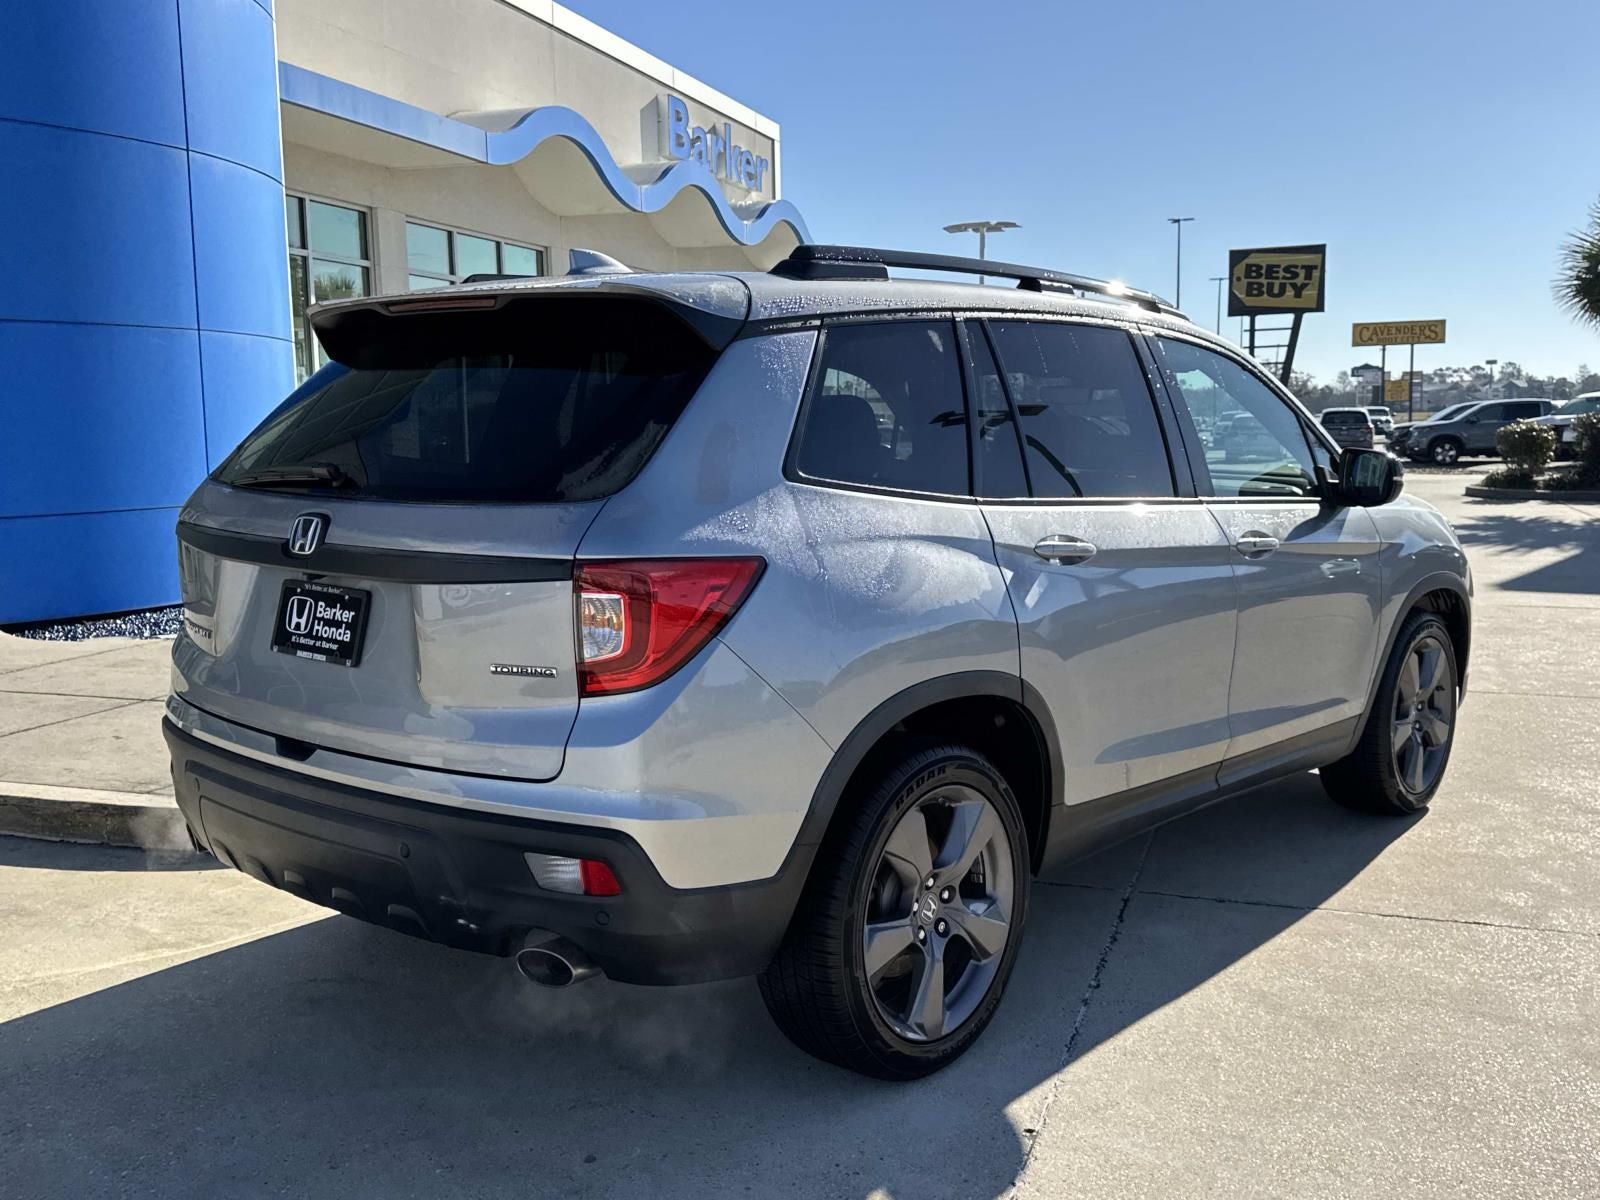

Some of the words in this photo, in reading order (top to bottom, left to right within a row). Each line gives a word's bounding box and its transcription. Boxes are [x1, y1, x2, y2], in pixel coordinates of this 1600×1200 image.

[667, 94, 769, 193] Barker
[1244, 263, 1319, 281] BEST
[1245, 281, 1311, 298] BUY
[316, 601, 355, 623] Barker
[312, 619, 351, 642] Honda
[291, 635, 300, 643] It's
[299, 636, 315, 646] Better
[321, 640, 339, 650] Barker
[490, 664, 557, 678] TOURING
[895, 766, 946, 810] RADAR
